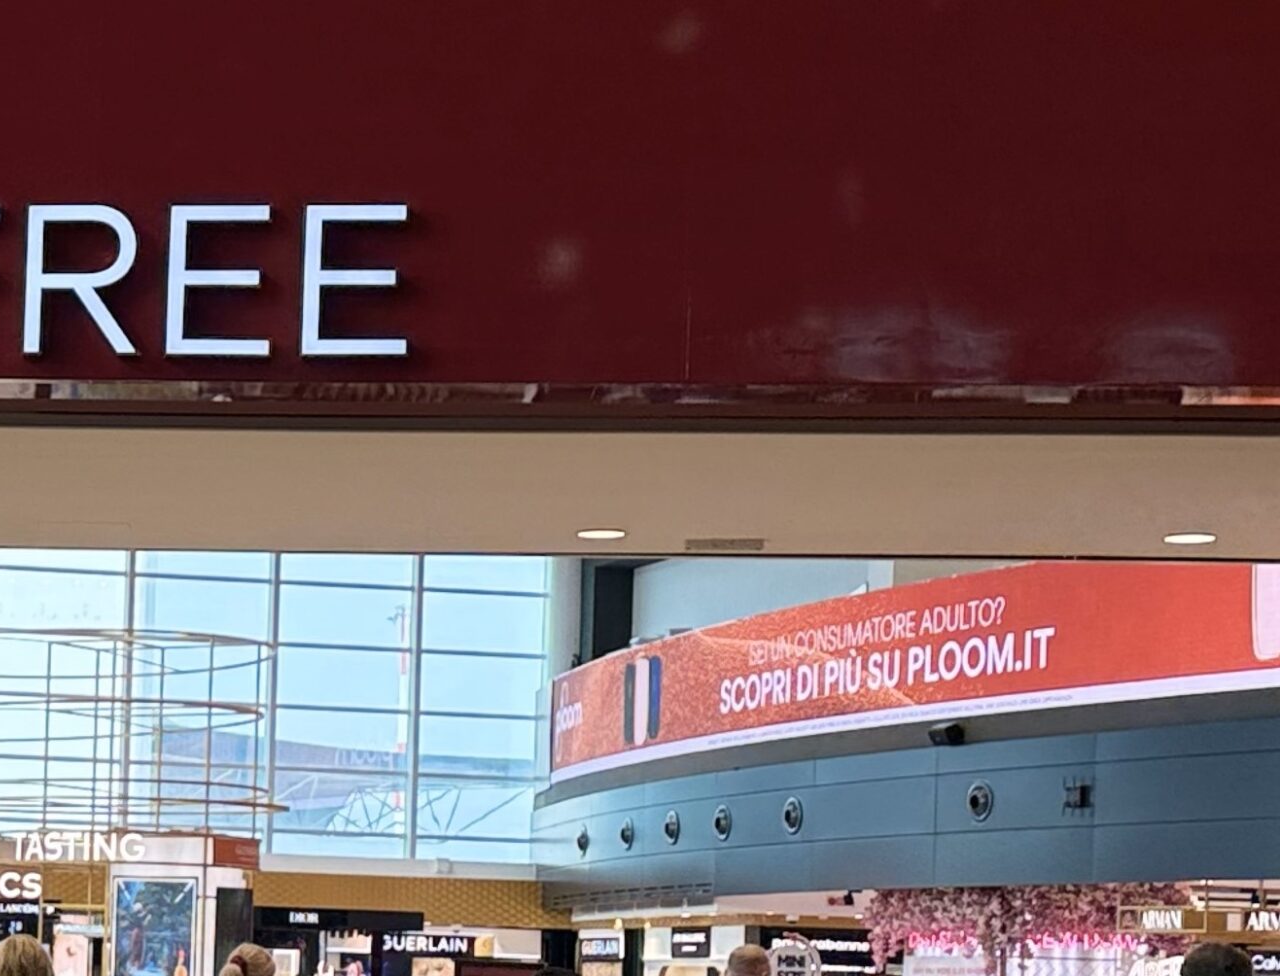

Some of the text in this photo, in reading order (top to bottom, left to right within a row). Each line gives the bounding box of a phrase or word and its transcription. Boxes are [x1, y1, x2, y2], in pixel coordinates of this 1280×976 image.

[790, 610, 916, 656] CONSUMATORE
[919, 596, 1006, 637] ADULTO?
[720, 627, 1055, 714] SCOPRI DI PIÙ SU PLOOM.IT
[15, 832, 146, 862] TASTING
[777, 954, 806, 968] MINI
